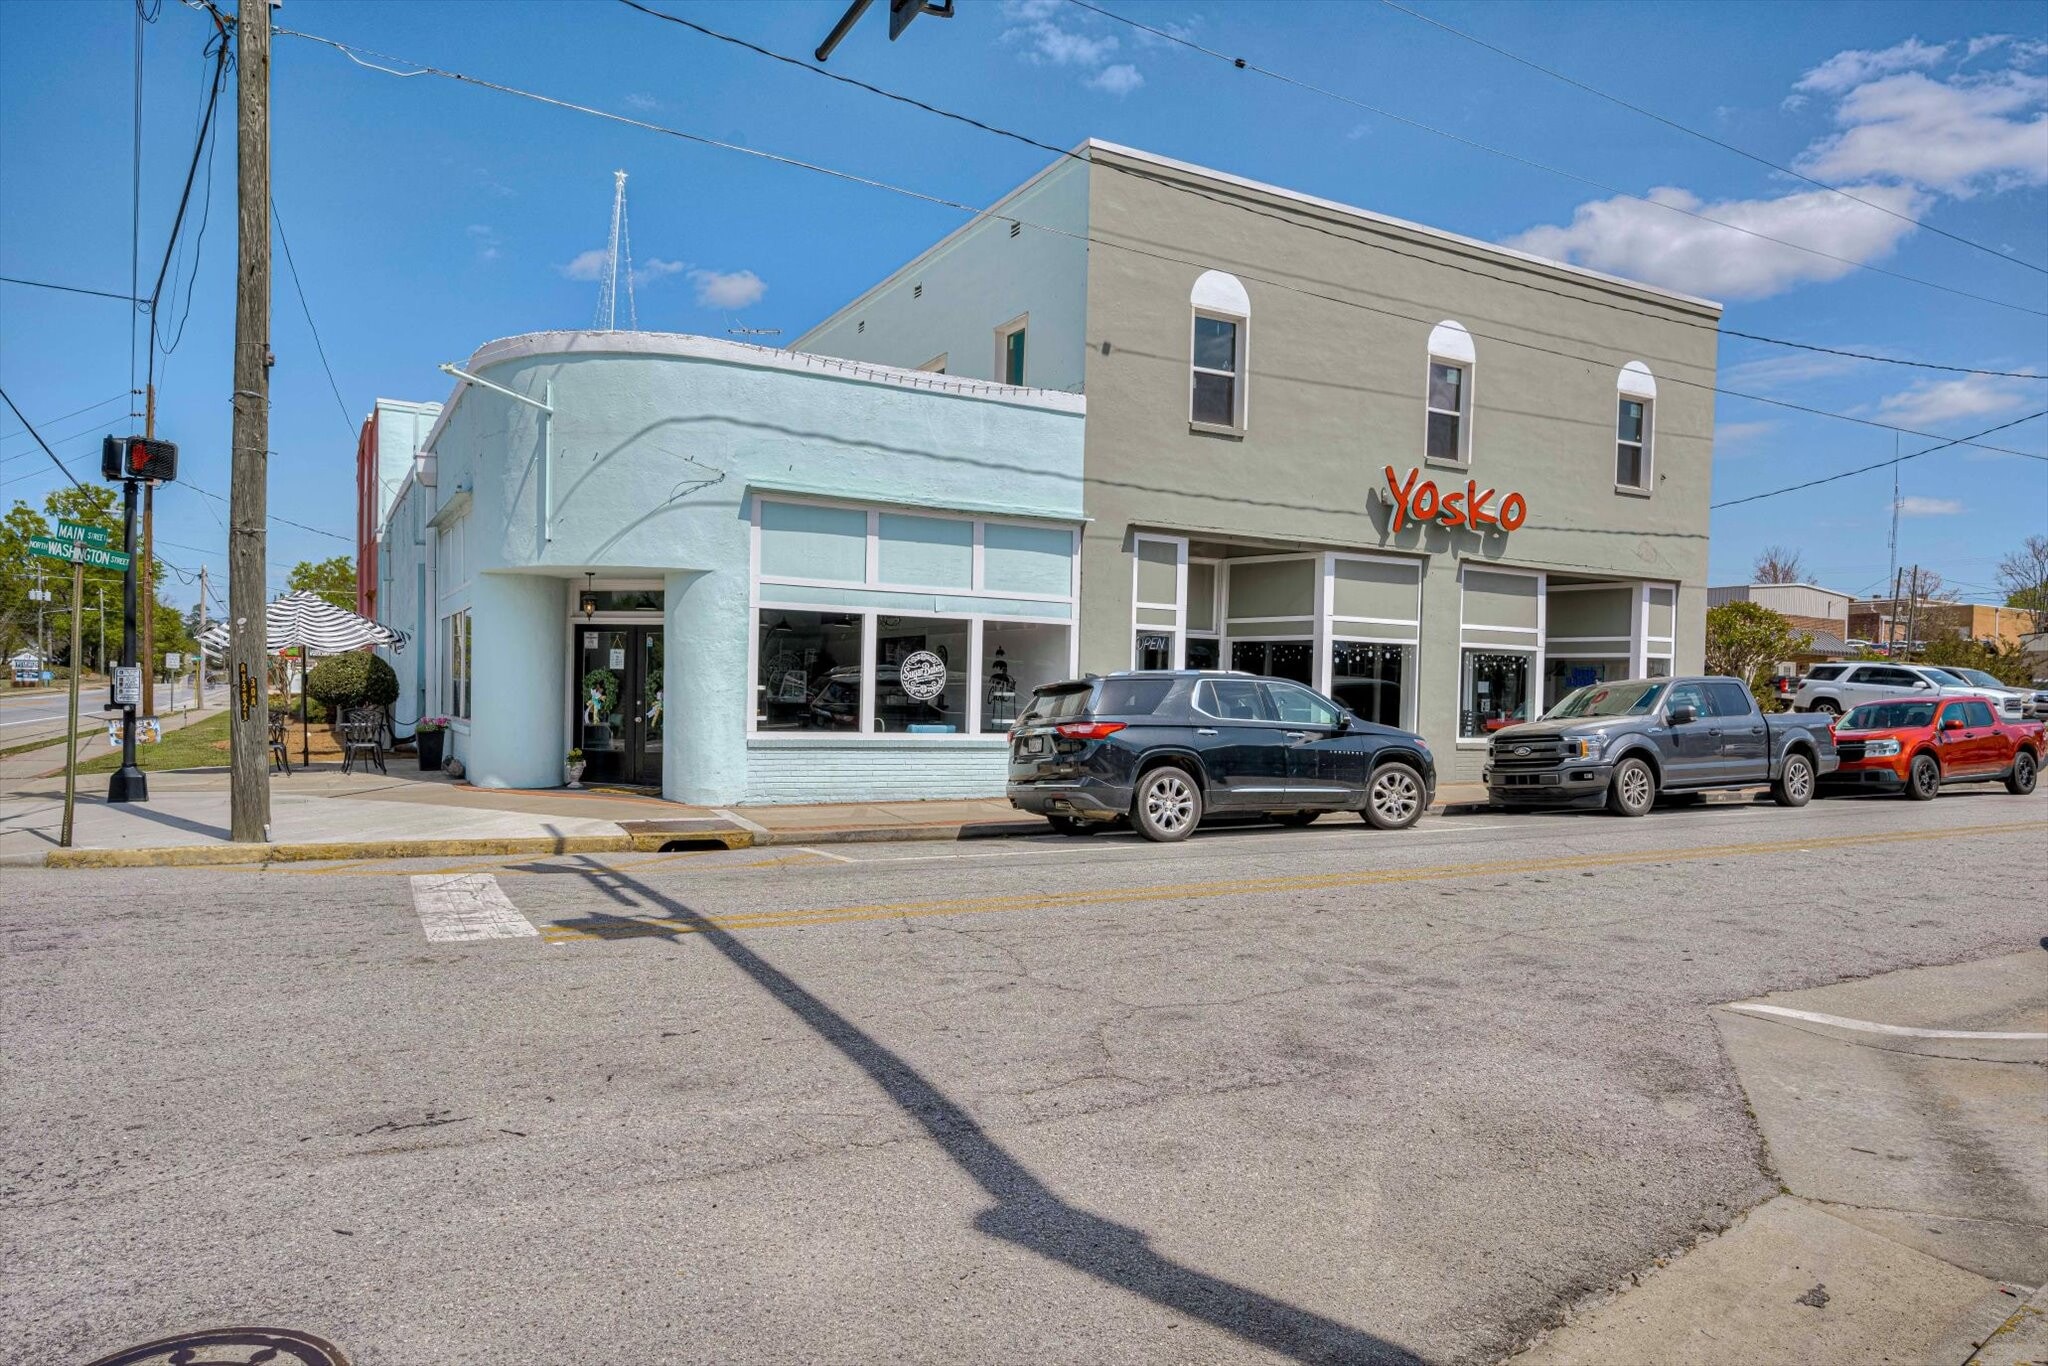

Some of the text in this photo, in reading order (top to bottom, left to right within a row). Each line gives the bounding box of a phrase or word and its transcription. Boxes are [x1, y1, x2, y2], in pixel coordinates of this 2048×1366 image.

[58, 524, 107, 542] MAIN STREET
[29, 540, 130, 566] NORTH WASHNGTON STREET
[1137, 636, 1166, 650] OPEN
